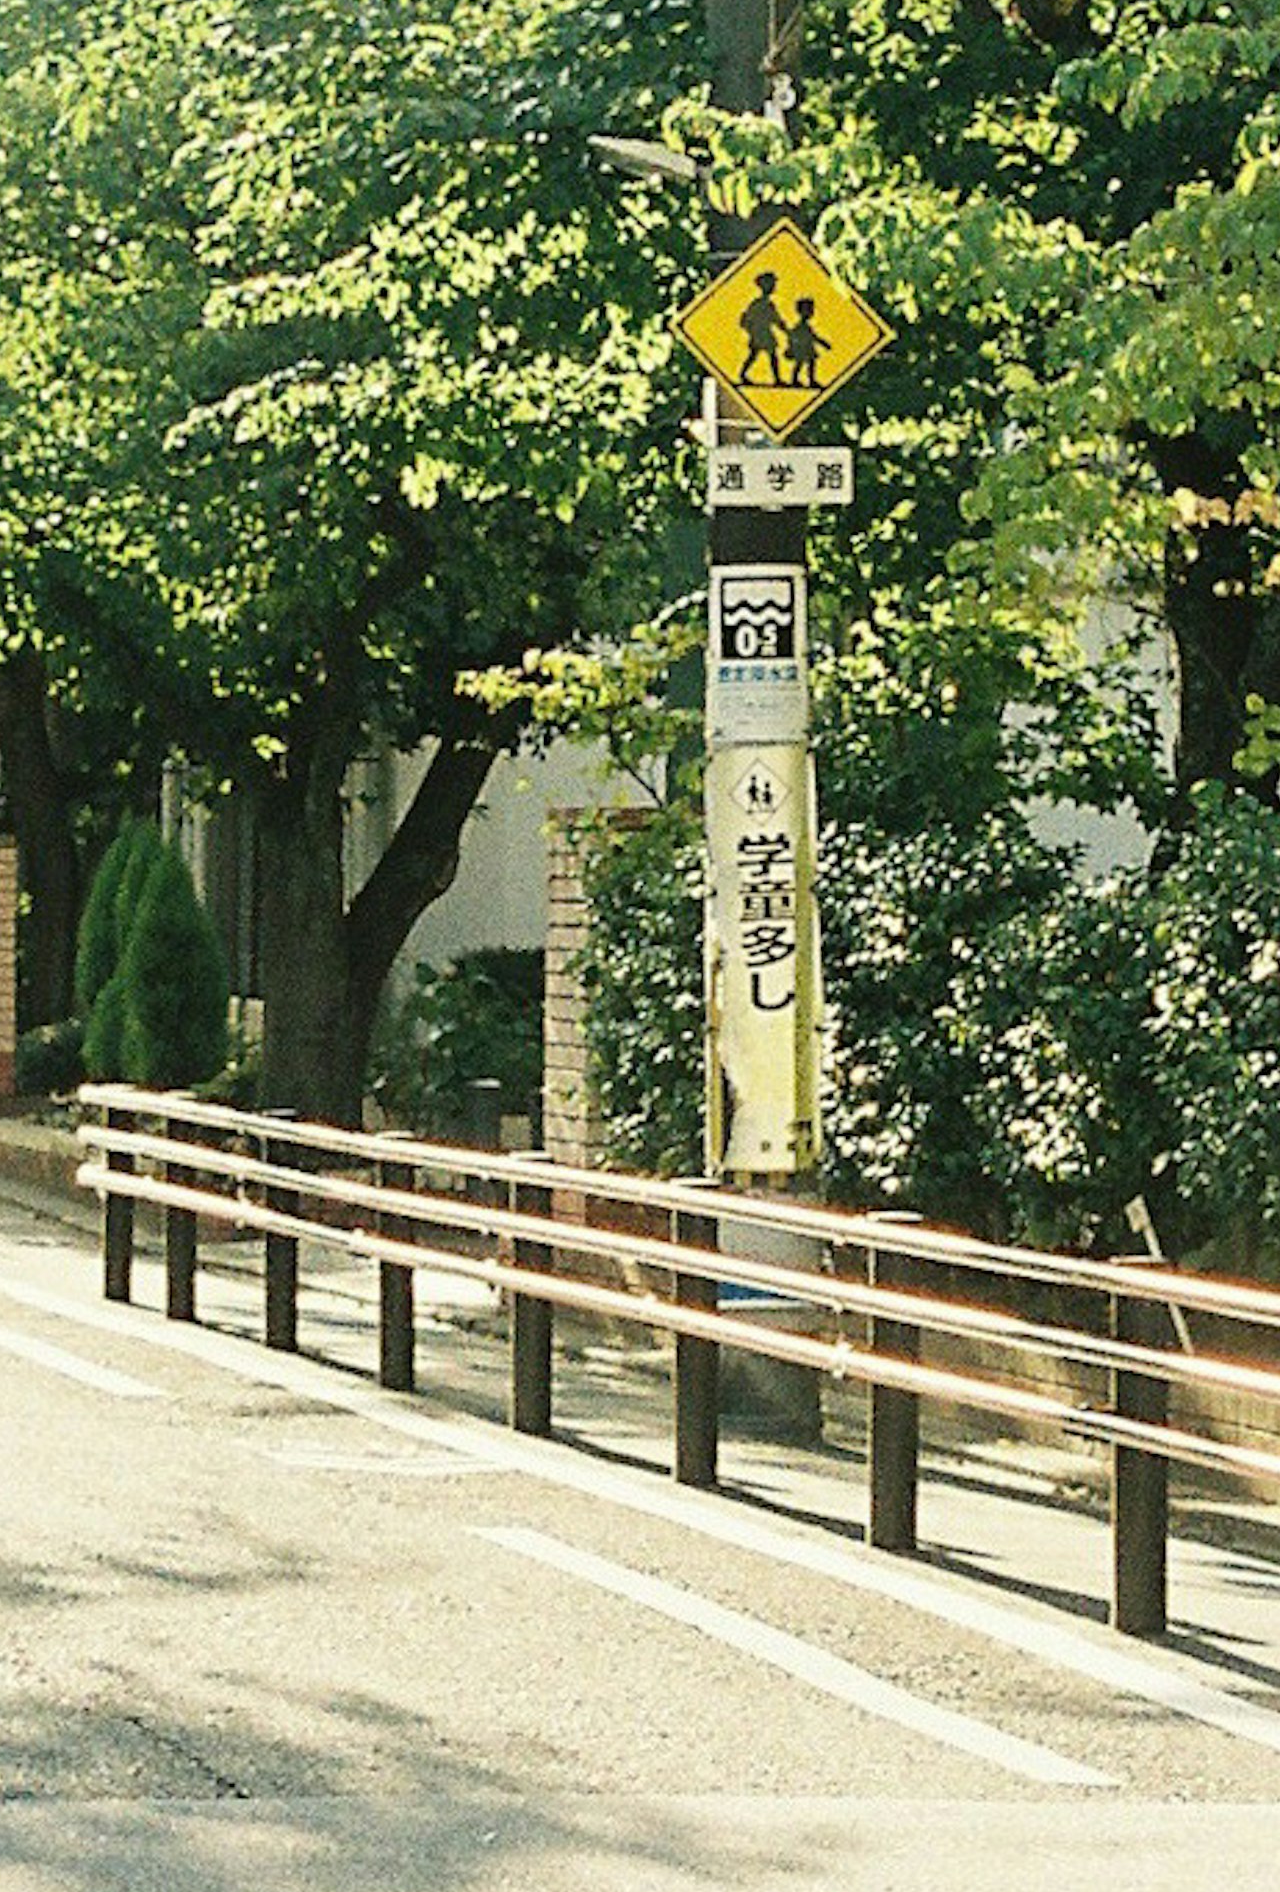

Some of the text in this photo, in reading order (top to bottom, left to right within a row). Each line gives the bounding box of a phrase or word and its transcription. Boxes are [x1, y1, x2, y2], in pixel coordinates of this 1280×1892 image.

[717, 463, 843, 491] 通学路
[737, 833, 796, 1010] 学童多し
